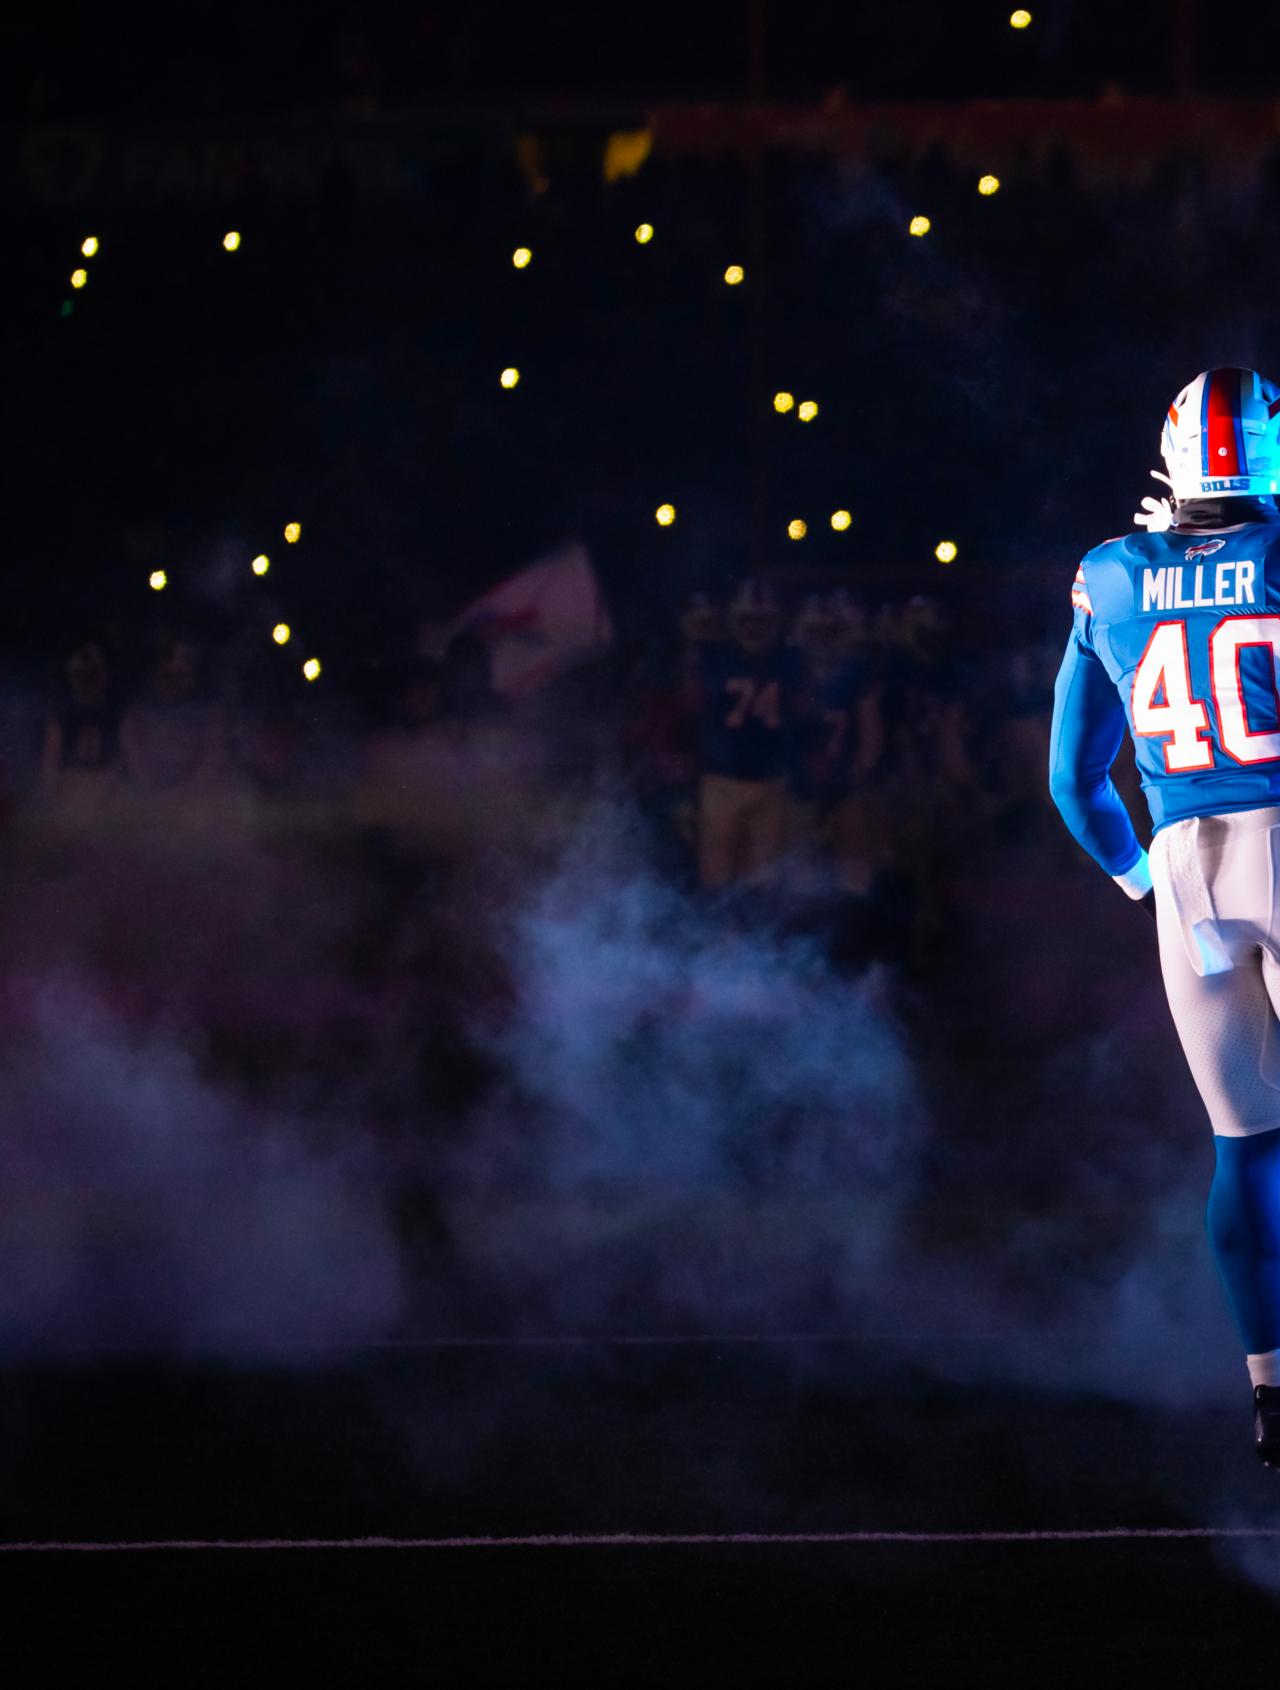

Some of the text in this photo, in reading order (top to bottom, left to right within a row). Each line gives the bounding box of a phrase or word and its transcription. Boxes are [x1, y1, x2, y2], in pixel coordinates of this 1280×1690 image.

[1200, 479, 1251, 493] BILLS
[1142, 560, 1255, 612] MILLER
[724, 677, 780, 732] 74
